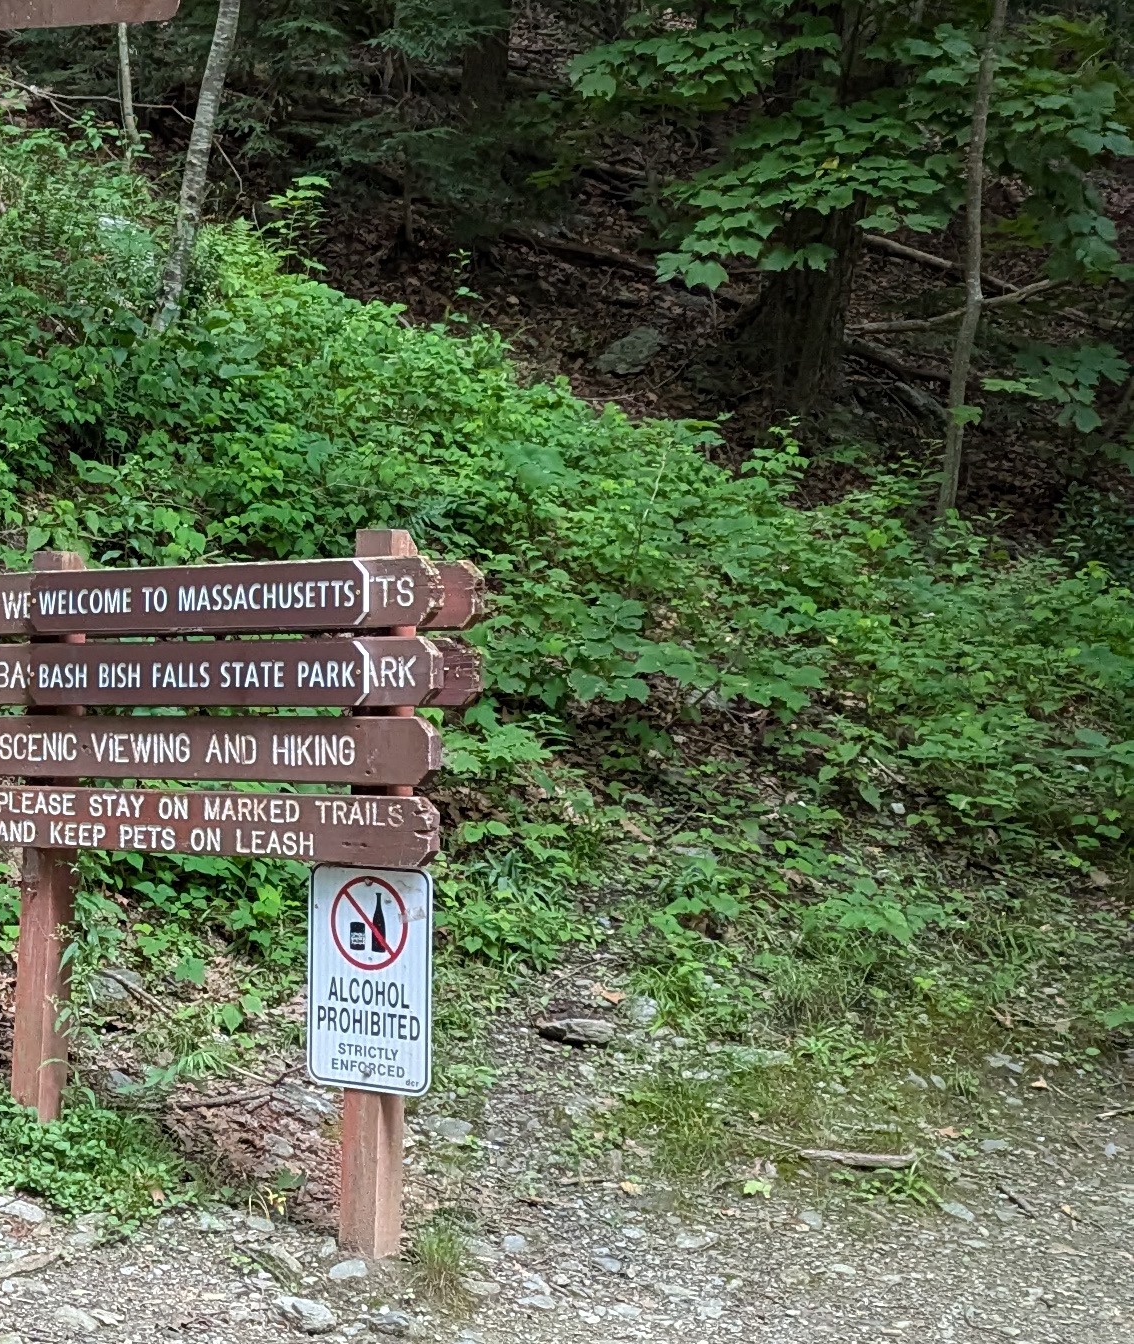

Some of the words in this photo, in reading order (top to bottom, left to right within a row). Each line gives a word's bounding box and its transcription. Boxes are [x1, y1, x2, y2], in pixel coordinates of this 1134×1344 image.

[38, 587, 132, 616] WELCOME
[141, 586, 168, 613] TO
[178, 580, 355, 612] MASSACHUSETTS
[38, 662, 88, 689] BASH
[98, 662, 142, 689] BISH
[152, 661, 210, 689] FALLS
[220, 661, 285, 689] STATE
[297, 660, 356, 688] PARK
[205, 733, 257, 766] AND
[271, 734, 356, 767] HIKING
[89, 793, 145, 818] STAY
[158, 795, 189, 820] ON
[203, 796, 300, 824] MARKED
[315, 801, 405, 828] TRAILS
[49, 821, 107, 847] KEEP
[119, 824, 176, 851] PETS
[190, 827, 221, 852] ON
[235, 828, 315, 856] LEASH
[328, 976, 410, 1010] ALCOHOL
[317, 1005, 421, 1041] PROHIBITED
[331, 1058, 406, 1079] ENFORCED
[337, 1042, 399, 1062] STRICTLY
